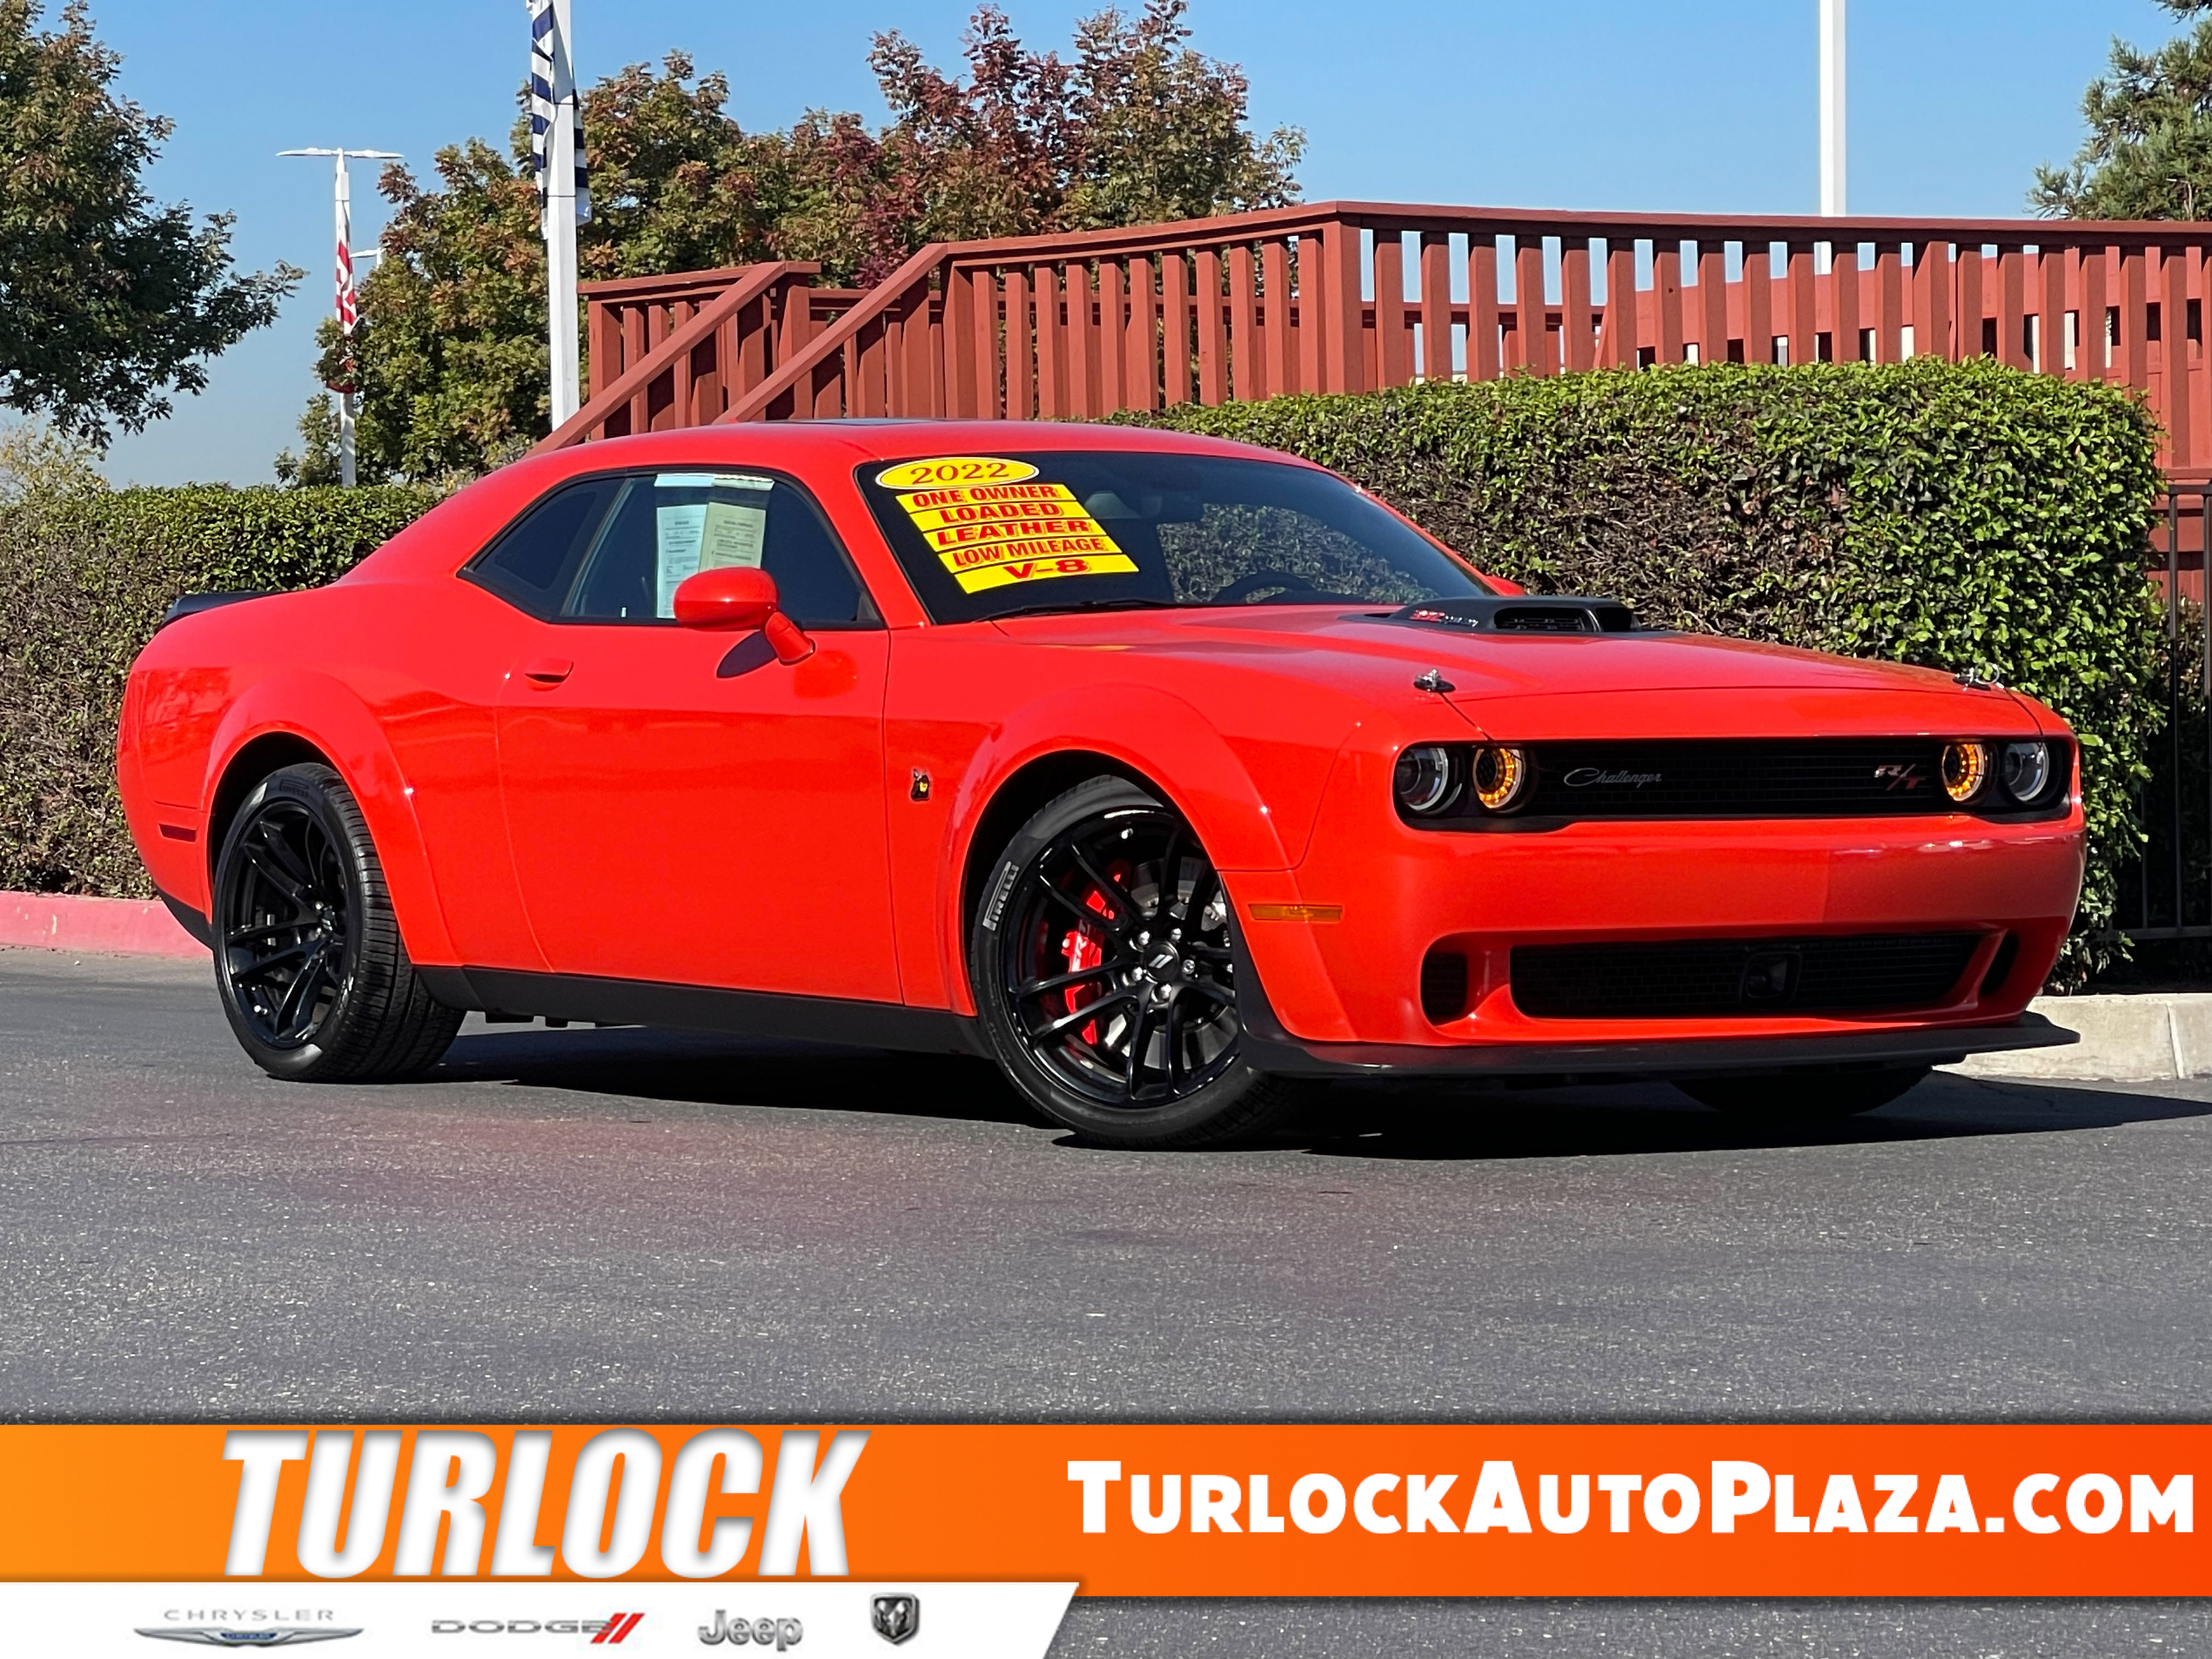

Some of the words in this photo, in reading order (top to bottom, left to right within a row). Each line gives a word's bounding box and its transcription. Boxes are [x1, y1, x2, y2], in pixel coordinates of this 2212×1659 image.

[910, 463, 1009, 485] 2022
[913, 489, 967, 507] ONE
[969, 486, 1059, 501] OWNER
[939, 503, 1063, 524] LOADED
[936, 520, 1092, 546] LEATHER
[952, 546, 1003, 567] LOW
[1006, 538, 1108, 558] MILEAGE
[1003, 558, 1091, 579] V-8
[1564, 768, 1662, 788] Challenger
[1874, 763, 1926, 791] R/T
[983, 861, 1020, 932] PIRELLI
